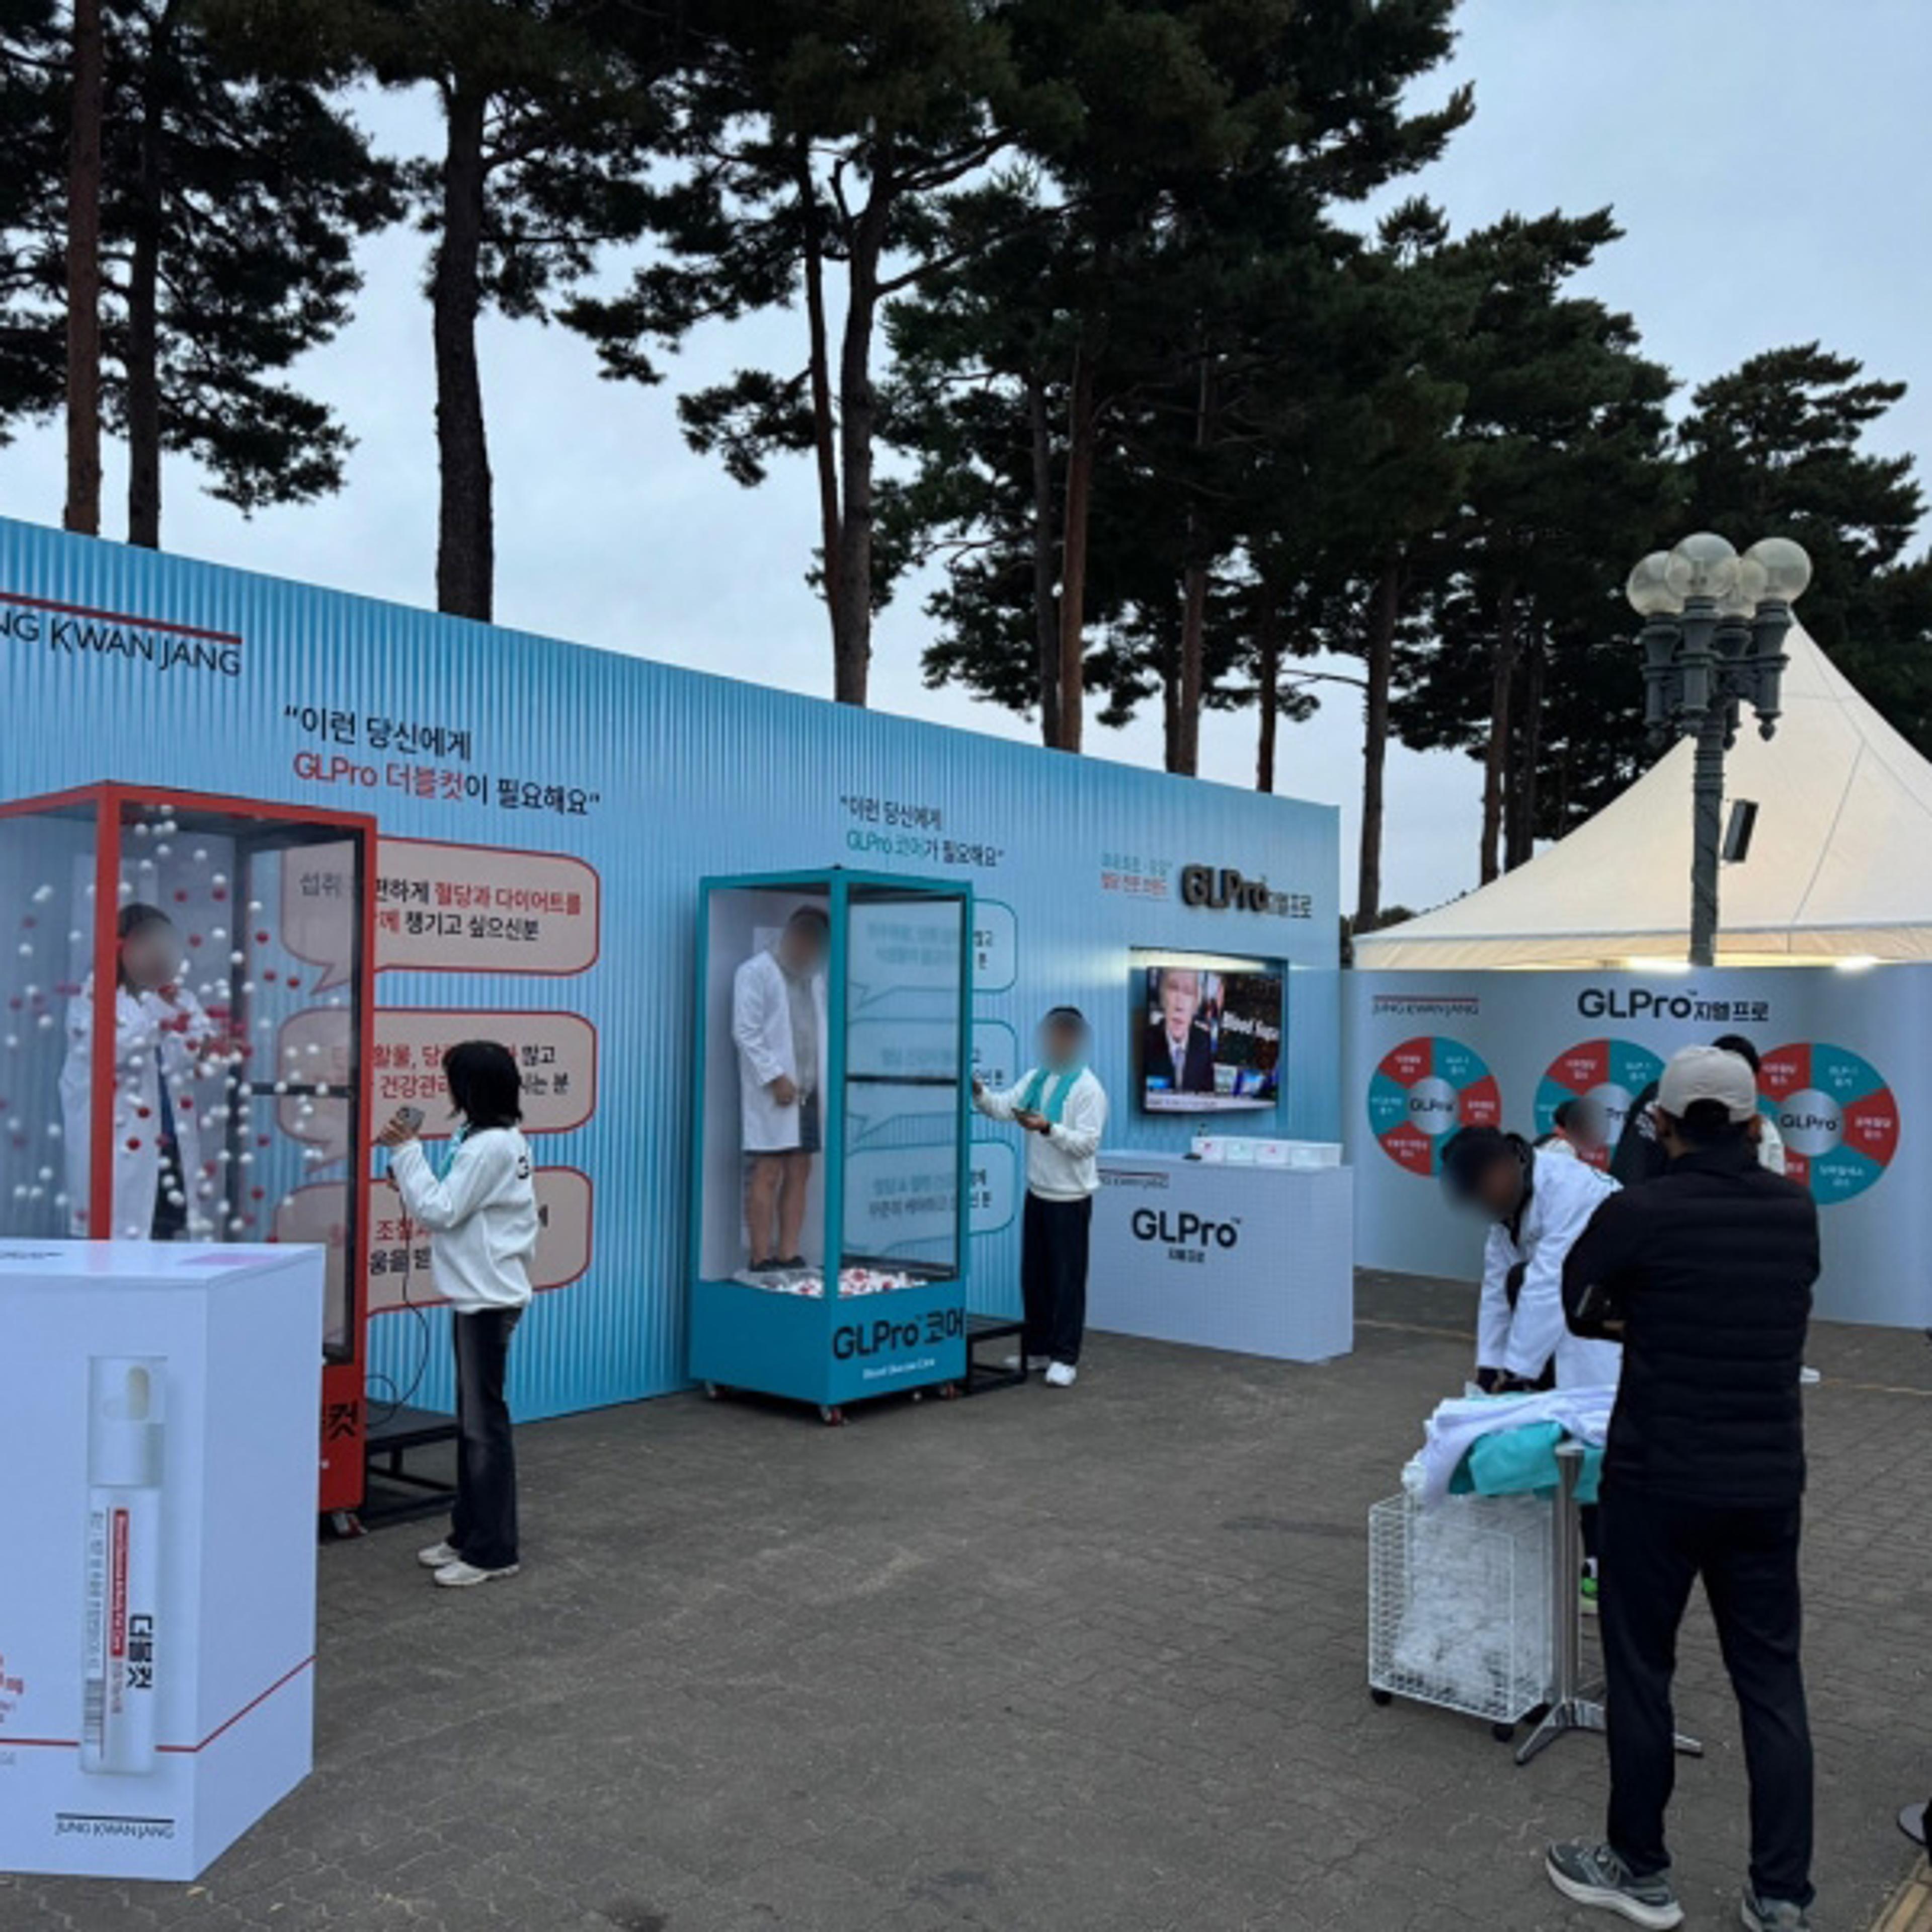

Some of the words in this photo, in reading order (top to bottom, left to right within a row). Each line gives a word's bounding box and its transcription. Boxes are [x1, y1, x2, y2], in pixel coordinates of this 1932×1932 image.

[50, 618, 153, 661] KWAN
[159, 638, 242, 677] JANG
[365, 716, 472, 761] 당신에게
[293, 752, 378, 787] GLPro
[385, 763, 488, 805] 더블컷이
[374, 876, 429, 906] 편하게
[435, 881, 491, 910] 혈당과
[495, 888, 582, 917] 다이어트를
[405, 912, 463, 936] 챙기고
[1577, 988, 1693, 1019] GLPro
[1132, 1208, 1238, 1249] GLPro
[369, 1249, 410, 1276] 움을
[833, 1319, 919, 1359] GLPro
[328, 1400, 359, 1442] 컷
[126, 1615, 153, 1689] 더블컷
